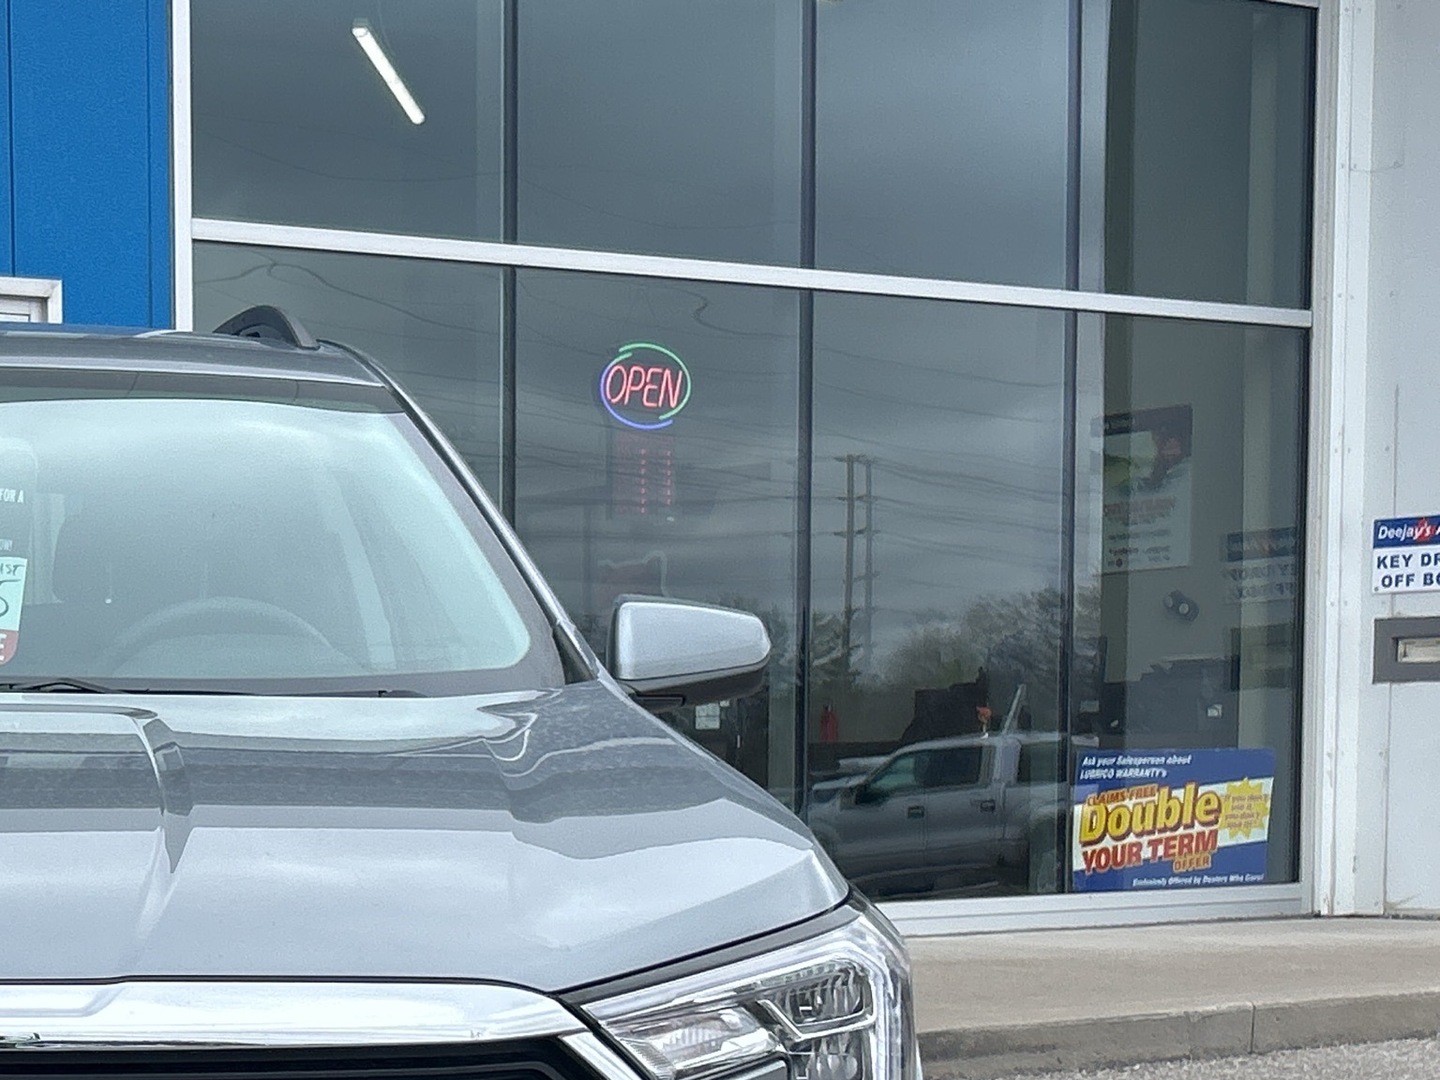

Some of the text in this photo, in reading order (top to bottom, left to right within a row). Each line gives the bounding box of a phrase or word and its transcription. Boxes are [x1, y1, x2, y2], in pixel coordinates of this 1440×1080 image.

[606, 365, 683, 408] OPEN
[17, 490, 25, 503] A
[1378, 521, 1432, 541] Deejay's
[1377, 553, 1413, 569] KEY
[1381, 573, 1415, 588] OFF
[1080, 781, 1221, 845] Double
[1083, 829, 1219, 874] YOUR TERM
[1174, 856, 1211, 872] OFFER
